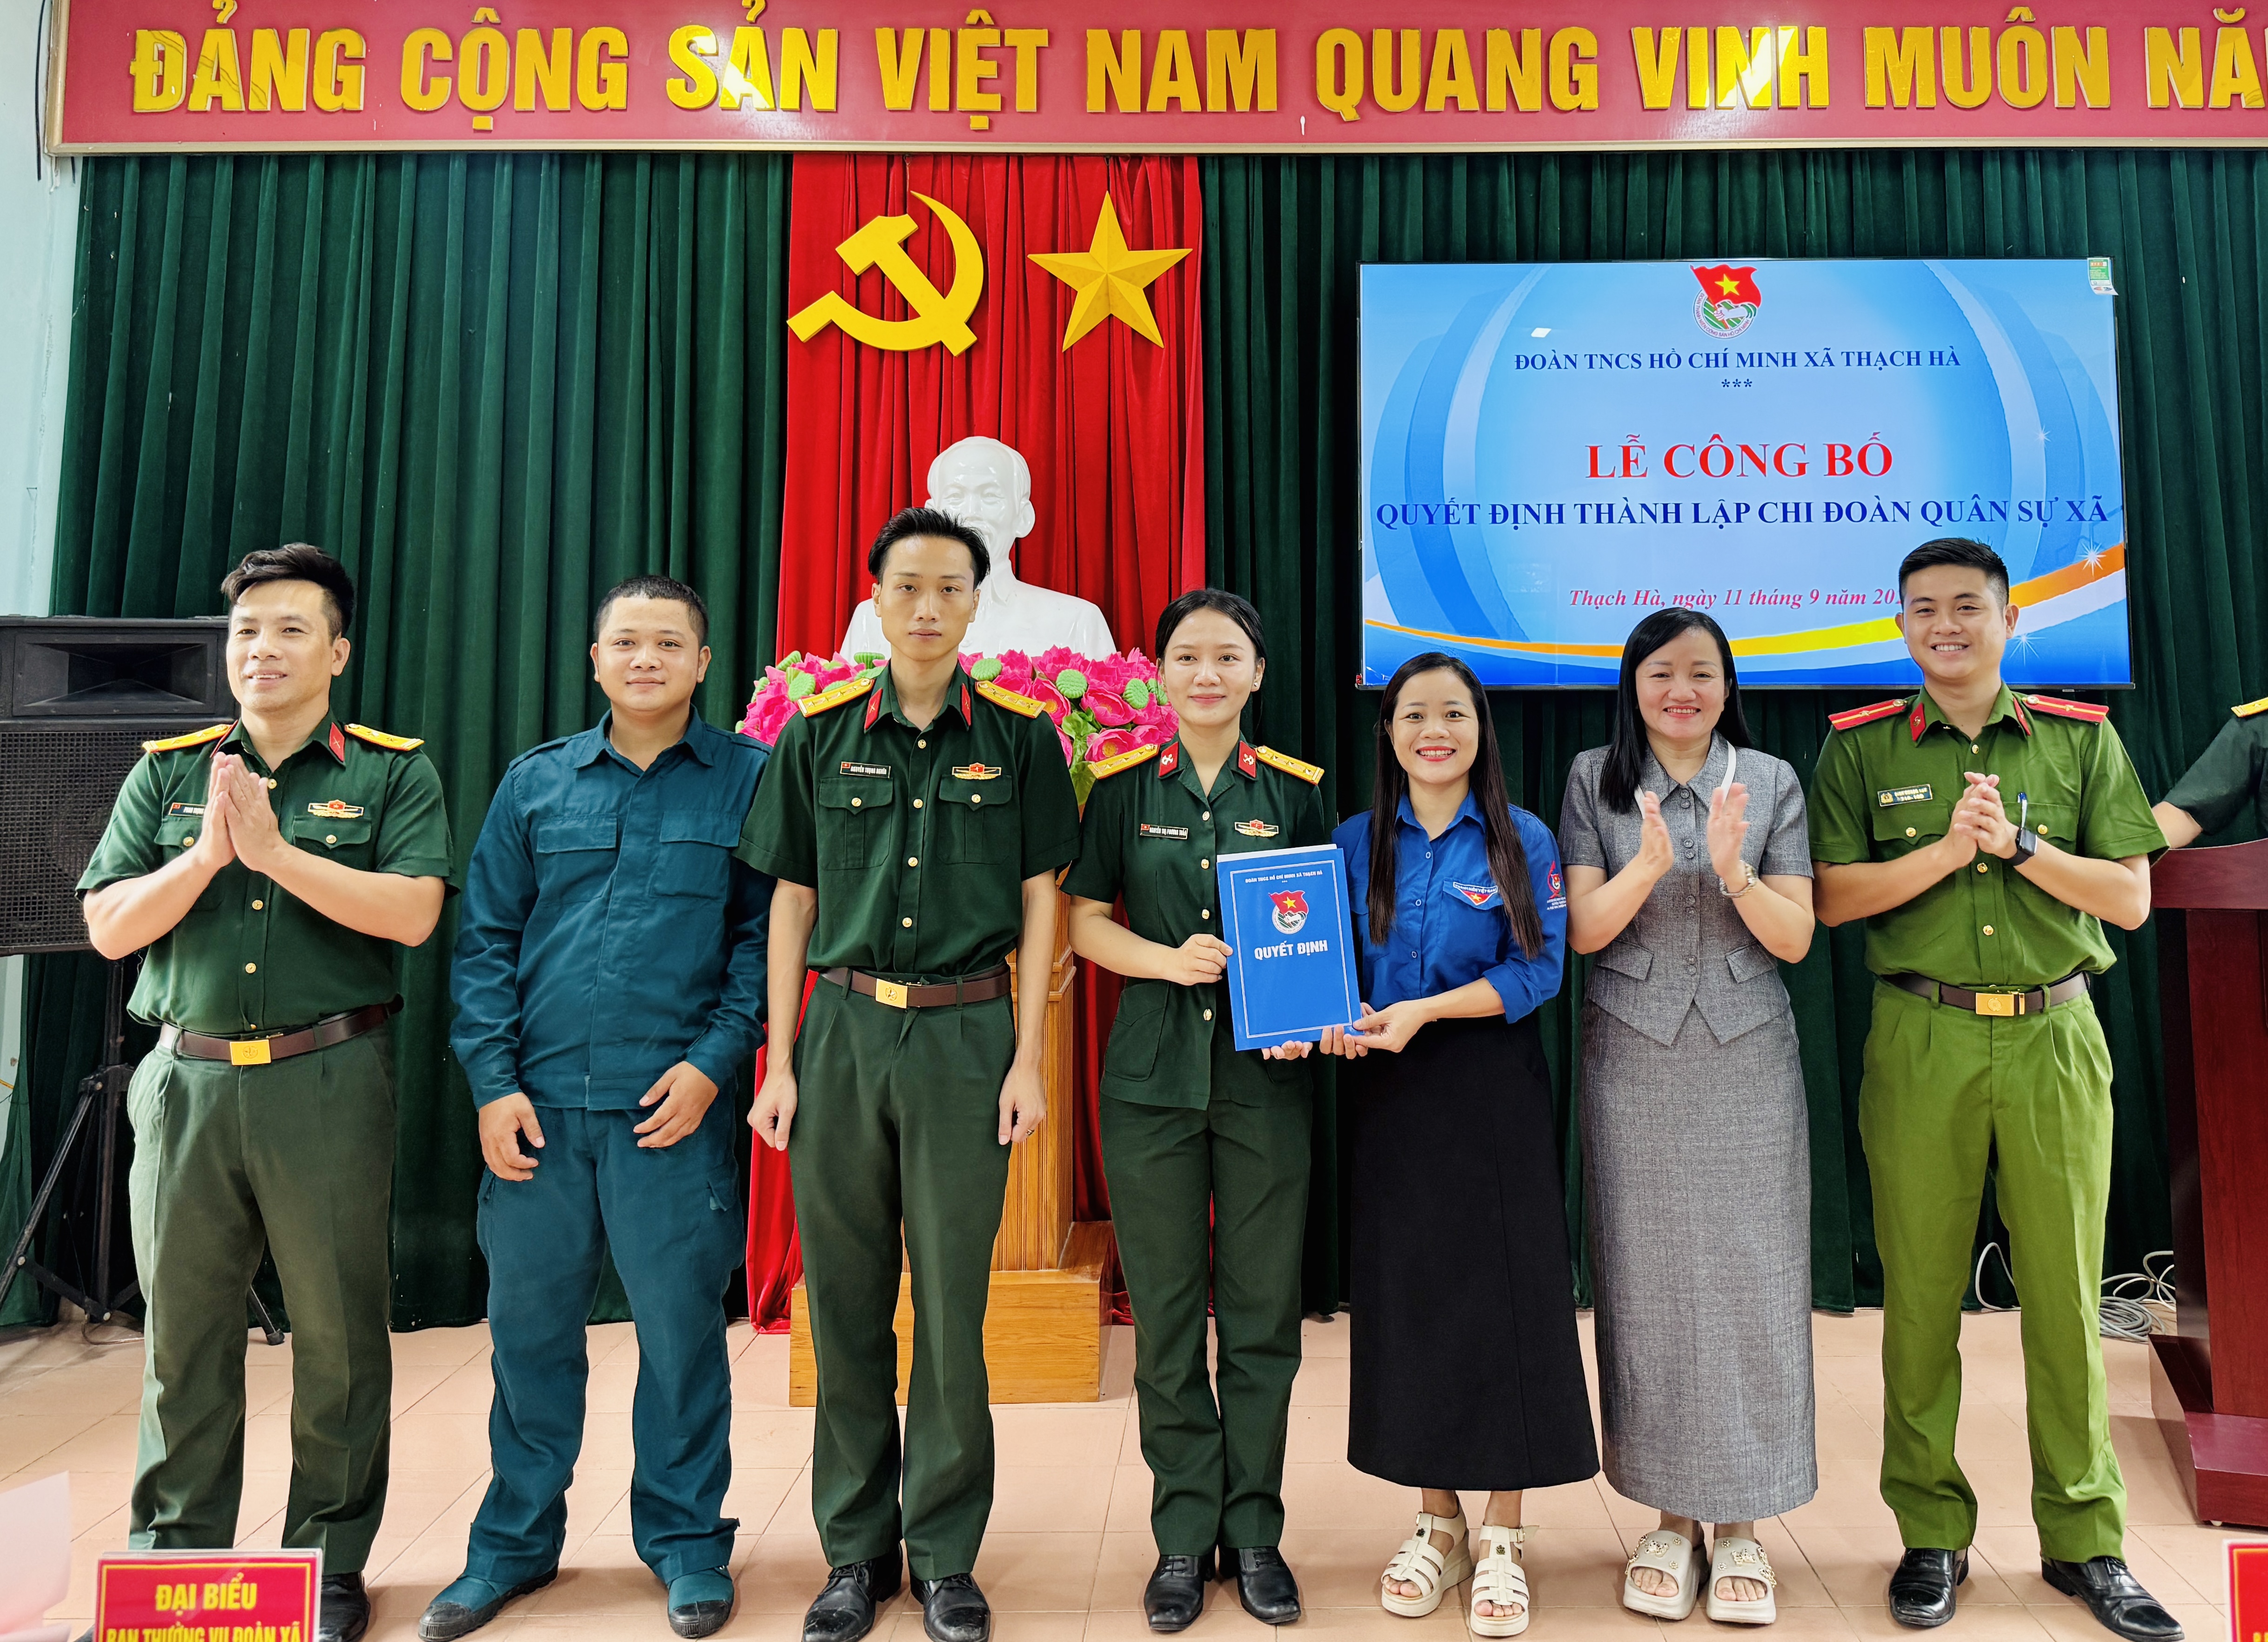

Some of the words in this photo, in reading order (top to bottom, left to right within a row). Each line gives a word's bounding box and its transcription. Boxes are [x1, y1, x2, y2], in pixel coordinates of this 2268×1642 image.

[129, 0, 367, 113] ĐẢNG
[401, 7, 629, 131] CỘNG
[666, 0, 838, 112] SẢN
[875, 9, 1049, 130] VIỆT
[1086, 28, 1278, 113] NAM
[1315, 26, 1599, 122] QUANG
[1631, 25, 1830, 111] VINH
[1864, 6, 2111, 109] MUÔN
[2144, 7, 2268, 109] NĂ
[1514, 349, 1579, 370] ĐOÀN
[1584, 353, 1642, 369] TNCS
[1648, 348, 1682, 369] HỒ
[1688, 347, 1730, 369] CHÍ
[1736, 351, 1798, 368] MINH
[1804, 347, 1836, 368] XÃ
[1841, 350, 1923, 371] THẠCH
[1928, 347, 1961, 367] HÀ
[1585, 433, 1648, 478] LỄ
[1664, 433, 1809, 478] CÔNG
[1823, 431, 1893, 477] BỐ
[1376, 496, 1480, 530] QUYẾT
[1488, 503, 1566, 530] ĐỊNH
[1573, 496, 1682, 524] THÀNH
[1691, 498, 1751, 529] LẬP
[1758, 501, 1814, 524] CHI
[1822, 495, 1911, 523] ĐOÀN
[1920, 493, 2009, 527] QUÂN
[2018, 496, 2059, 528] SỰ
[2066, 494, 2108, 523] XÃ
[1570, 590, 1626, 609] Thạch
[1632, 589, 1666, 607] Hà,
[1672, 590, 1717, 610] ngày
[1723, 590, 1742, 605] 11
[1749, 590, 1803, 610] tháng
[1809, 589, 1820, 604] 9
[1826, 589, 1867, 605] năm
[1872, 588, 1901, 605] 20
[1254, 940, 1294, 960] QUYẾT
[1297, 940, 1328, 956] ĐỊNH
[154, 1583, 196, 1616] ĐẠI
[202, 1573, 258, 1610] BIỂU
